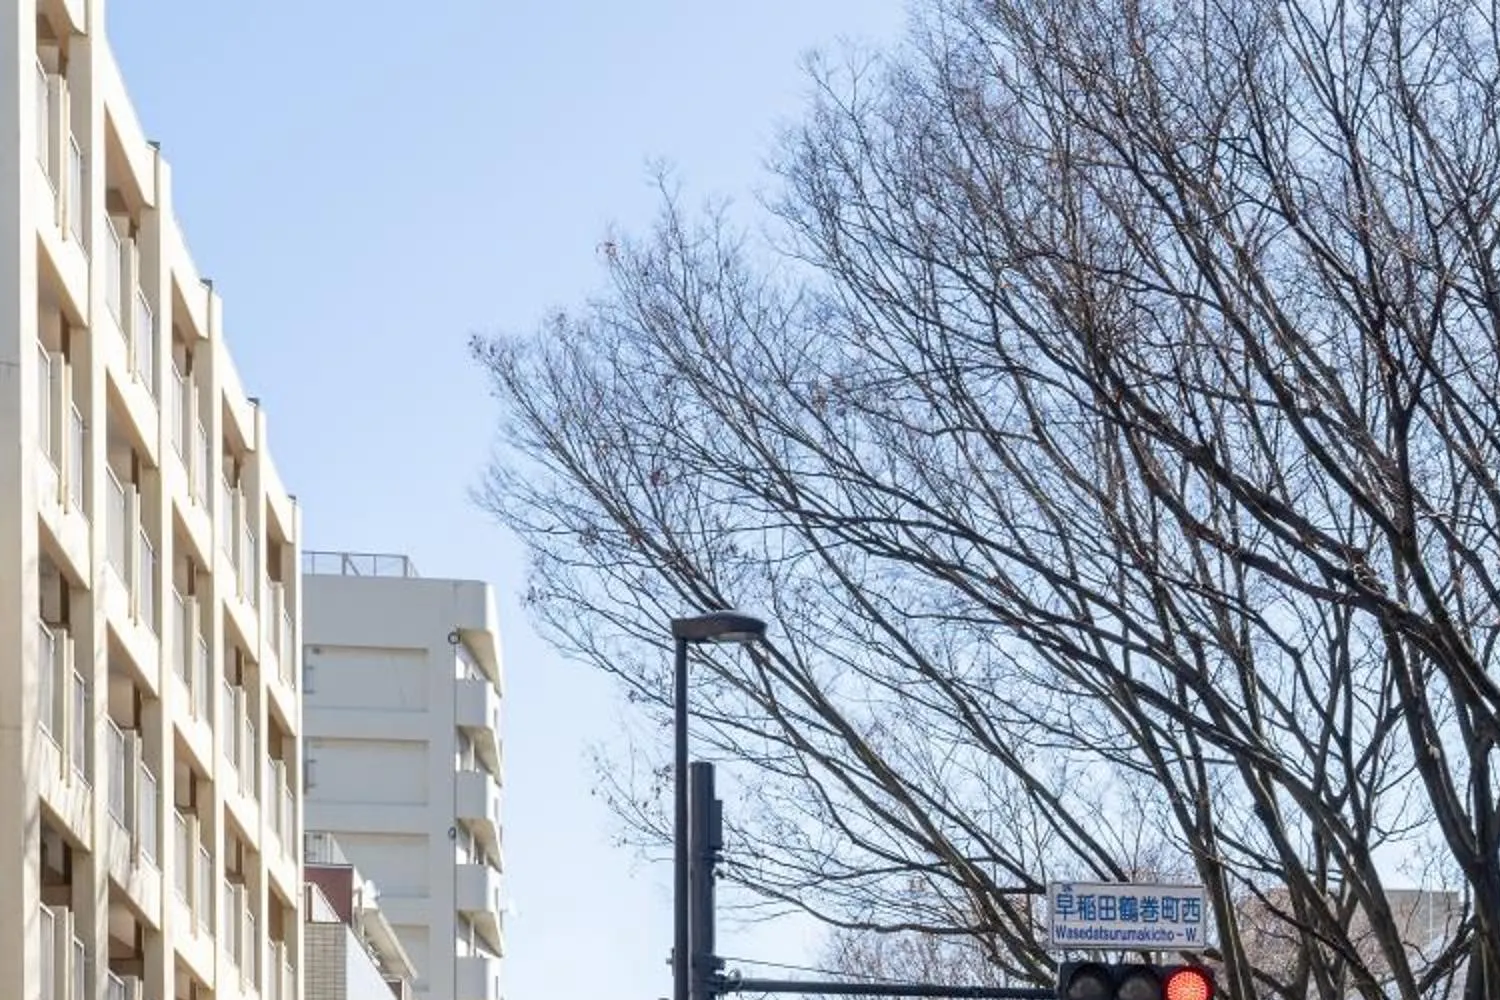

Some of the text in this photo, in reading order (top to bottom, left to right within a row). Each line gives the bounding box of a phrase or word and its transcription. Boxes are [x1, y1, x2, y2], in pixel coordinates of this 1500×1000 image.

[1055, 893, 1201, 923] 早稲田鶴巻町西
